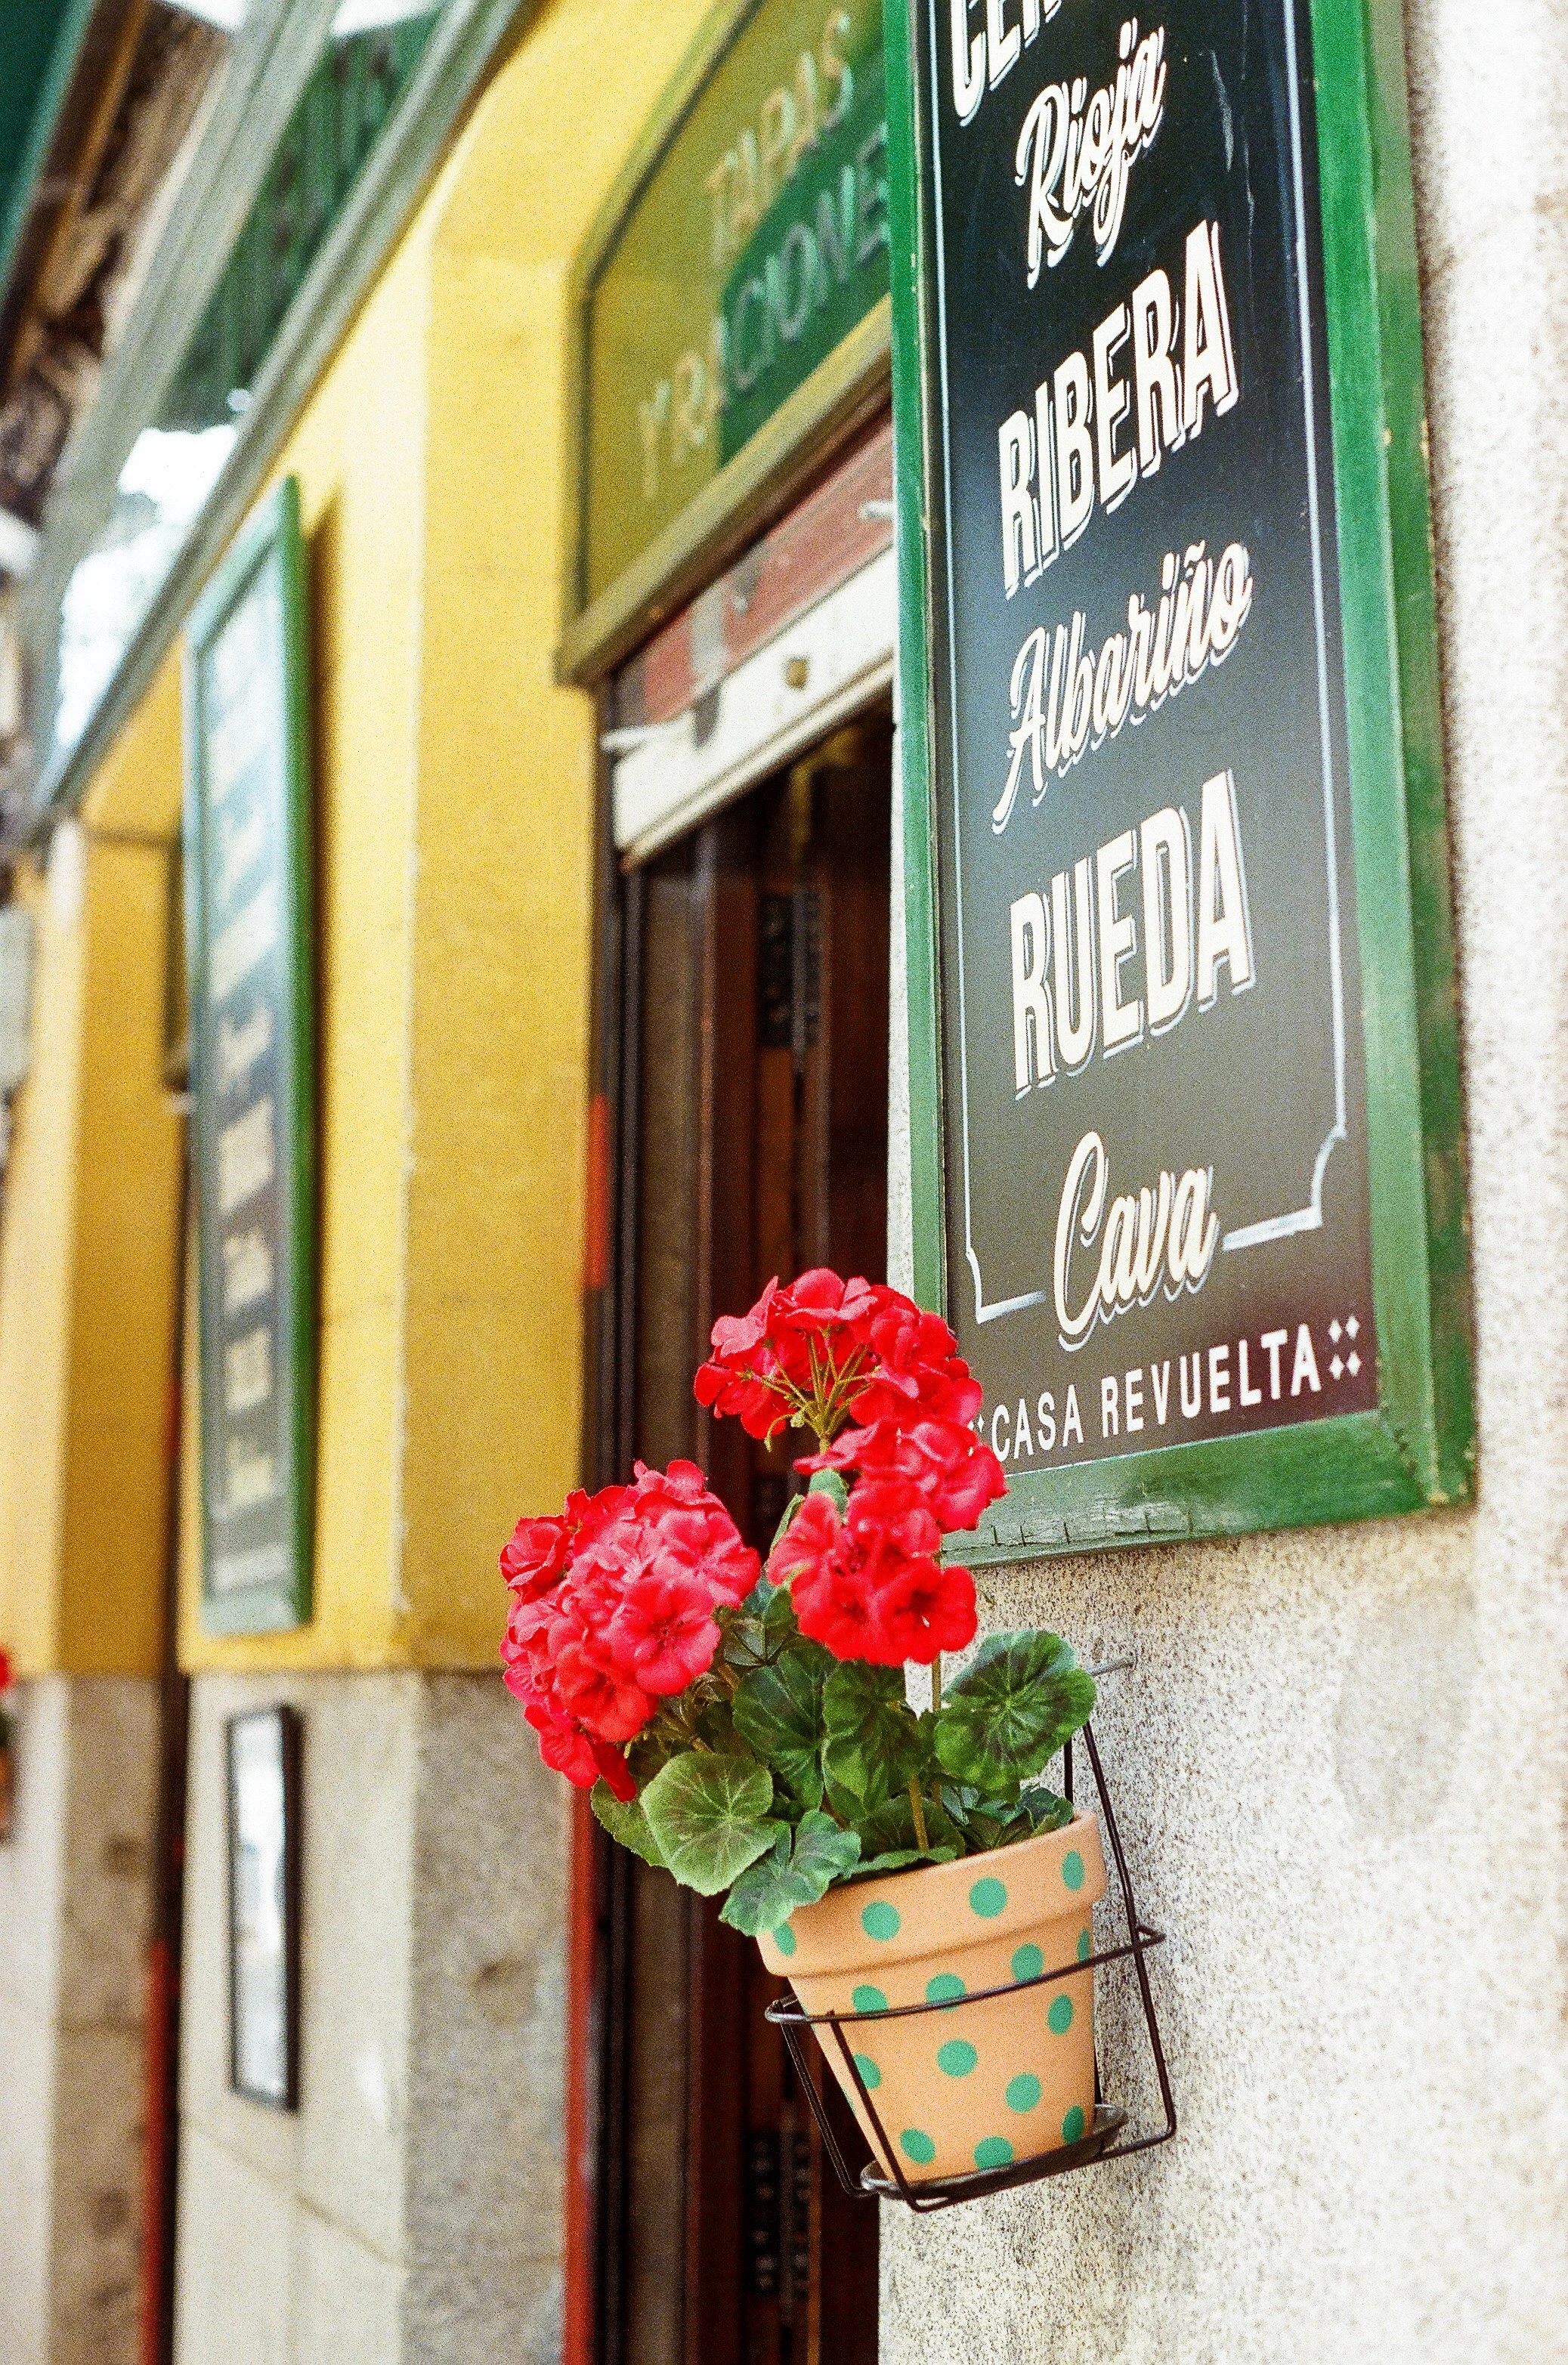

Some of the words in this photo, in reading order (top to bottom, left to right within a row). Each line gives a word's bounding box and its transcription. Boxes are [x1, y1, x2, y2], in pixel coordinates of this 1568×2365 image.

[1016, 18, 1165, 288] Rioja
[997, 219, 1239, 600] RIBERA
[992, 540, 1254, 833] Albariño
[1010, 768, 1256, 1100] RUEDA
[1054, 1131, 1220, 1352] Cava
[990, 1383, 1084, 1464] CASA
[1101, 1322, 1322, 1438] REVUELTA
